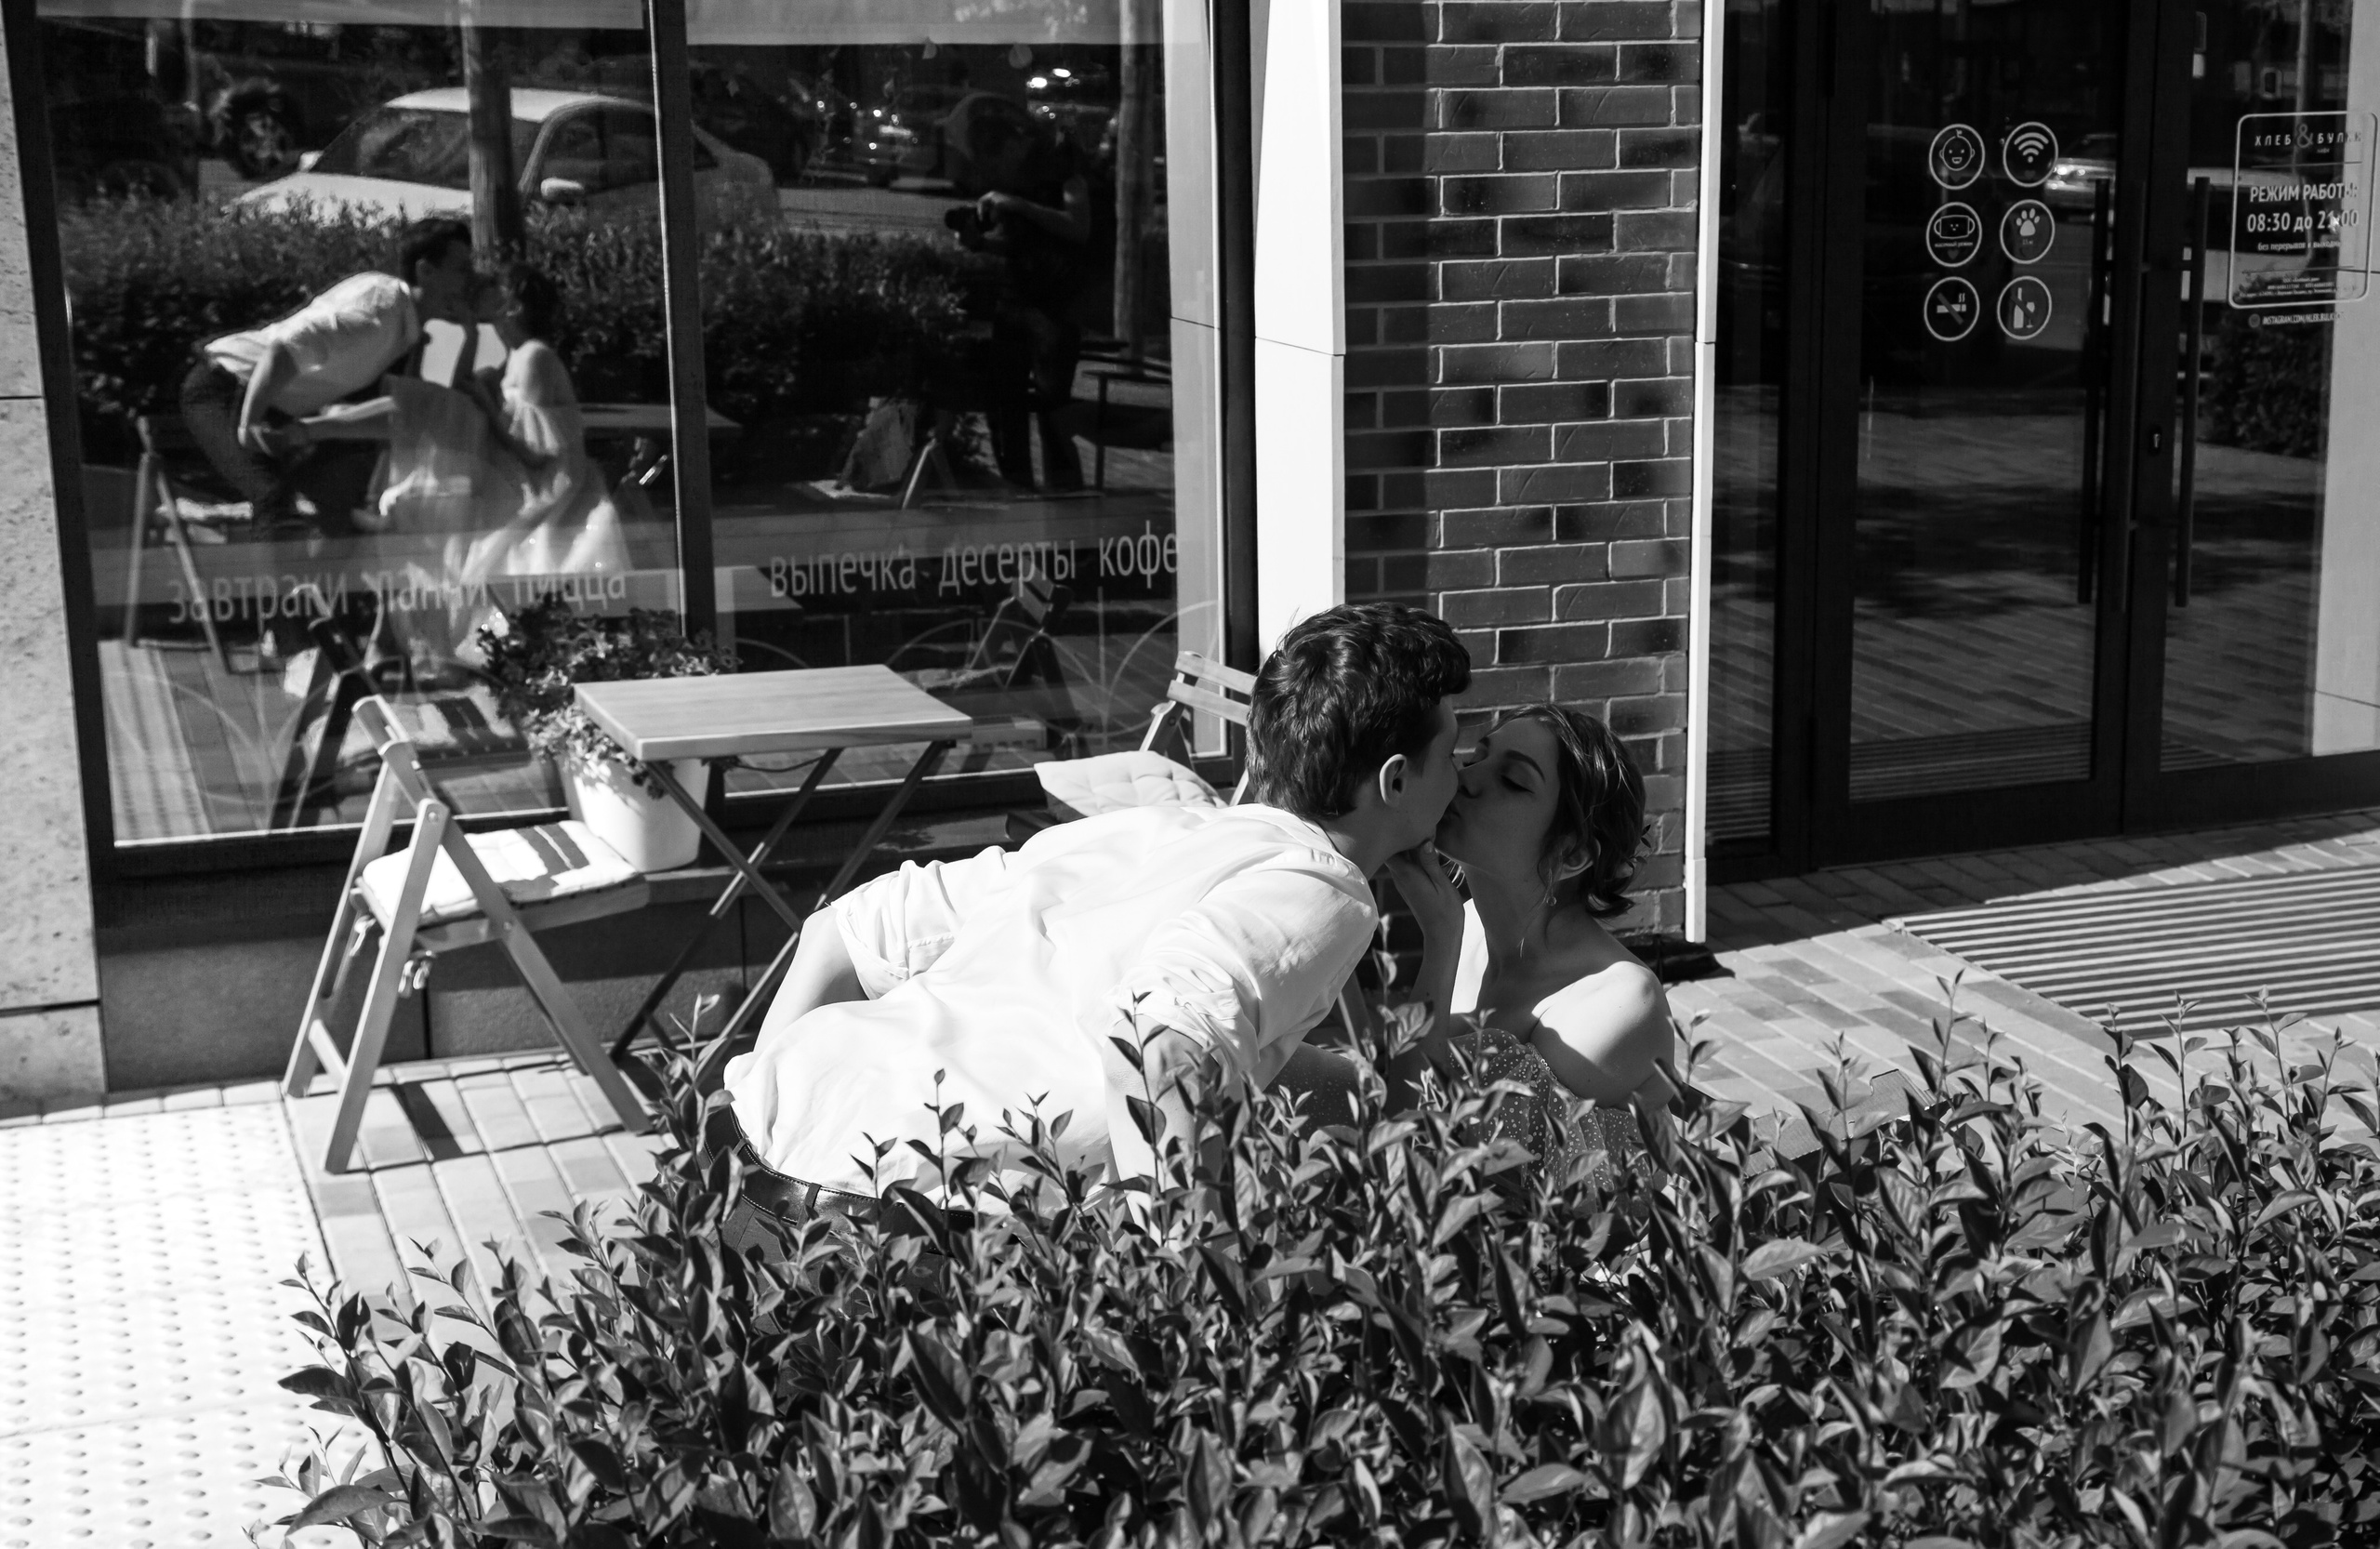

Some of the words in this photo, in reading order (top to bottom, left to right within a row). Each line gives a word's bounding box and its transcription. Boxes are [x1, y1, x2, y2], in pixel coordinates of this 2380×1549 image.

[2254, 135, 2292, 147] ХЛЕБ
[2295, 123, 2313, 149] &
[2250, 184, 2300, 203] РЕЖИМ
[2246, 212, 2291, 232] 08:30
[2293, 218, 2313, 232] до
[2257, 242, 2269, 251] без
[770, 547, 917, 598] выпечка
[938, 539, 1077, 598] десерты
[1098, 520, 1178, 589] кофе
[167, 573, 349, 637] завтраки
